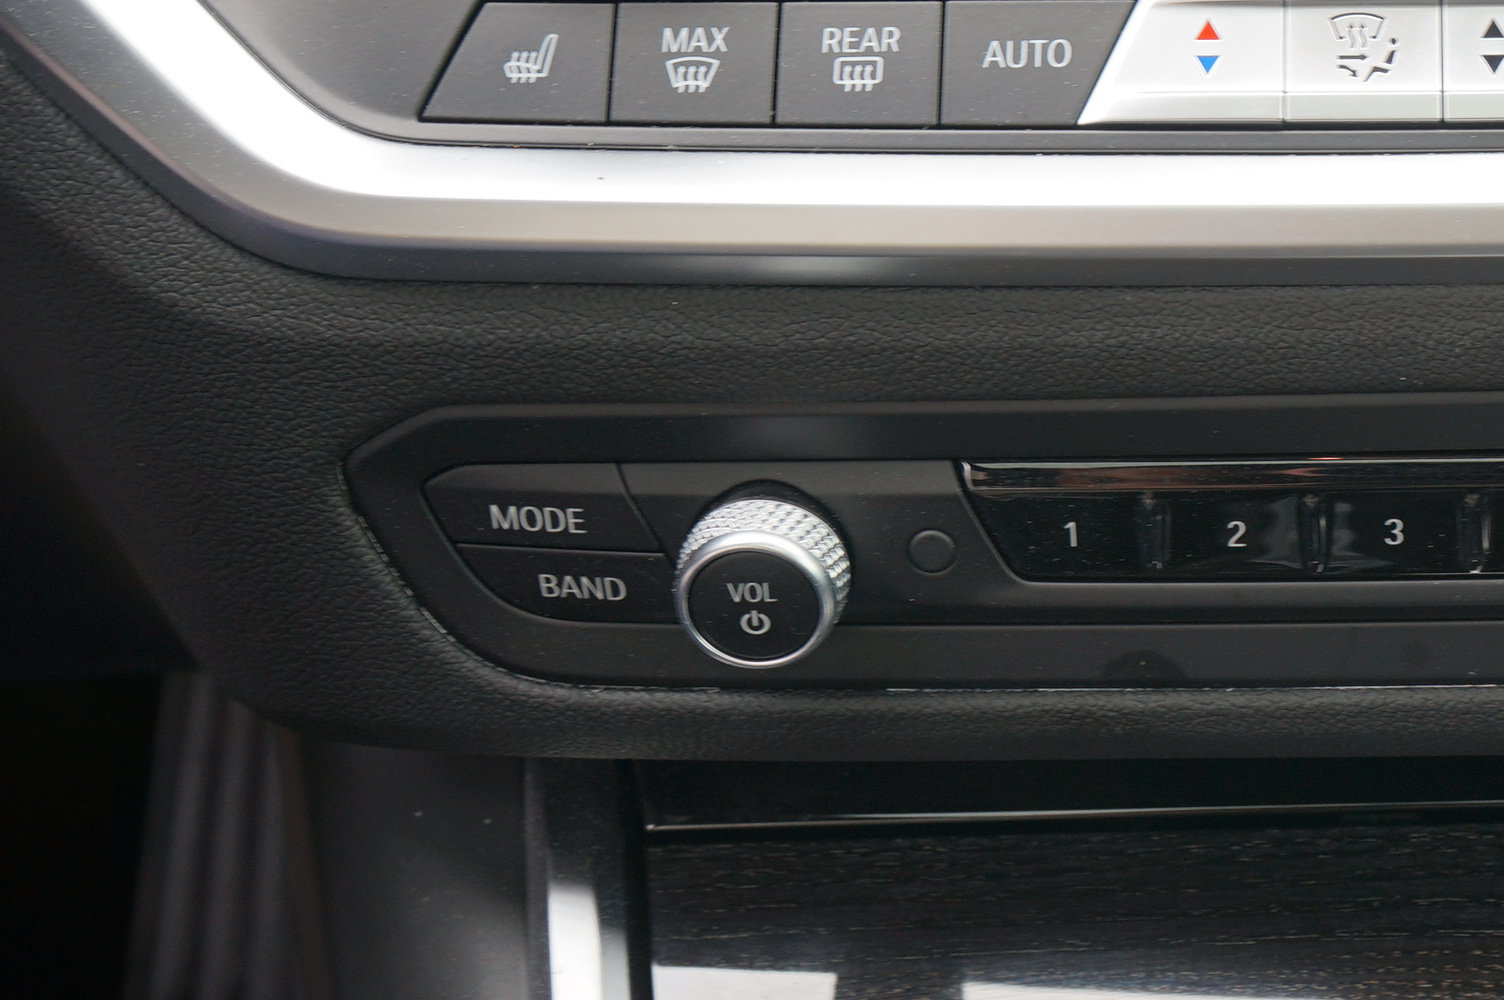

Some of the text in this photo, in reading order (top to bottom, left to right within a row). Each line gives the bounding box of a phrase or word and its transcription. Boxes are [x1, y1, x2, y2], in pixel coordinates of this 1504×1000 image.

[661, 26, 730, 53] MAX
[821, 26, 901, 53] REAR
[983, 38, 1072, 70] AUTO
[489, 504, 586, 534] MODE
[1383, 518, 1405, 545] 3
[1063, 521, 1078, 548] 1
[1226, 520, 1248, 548] 2
[538, 573, 627, 601] BAND
[726, 581, 777, 604] VOL
